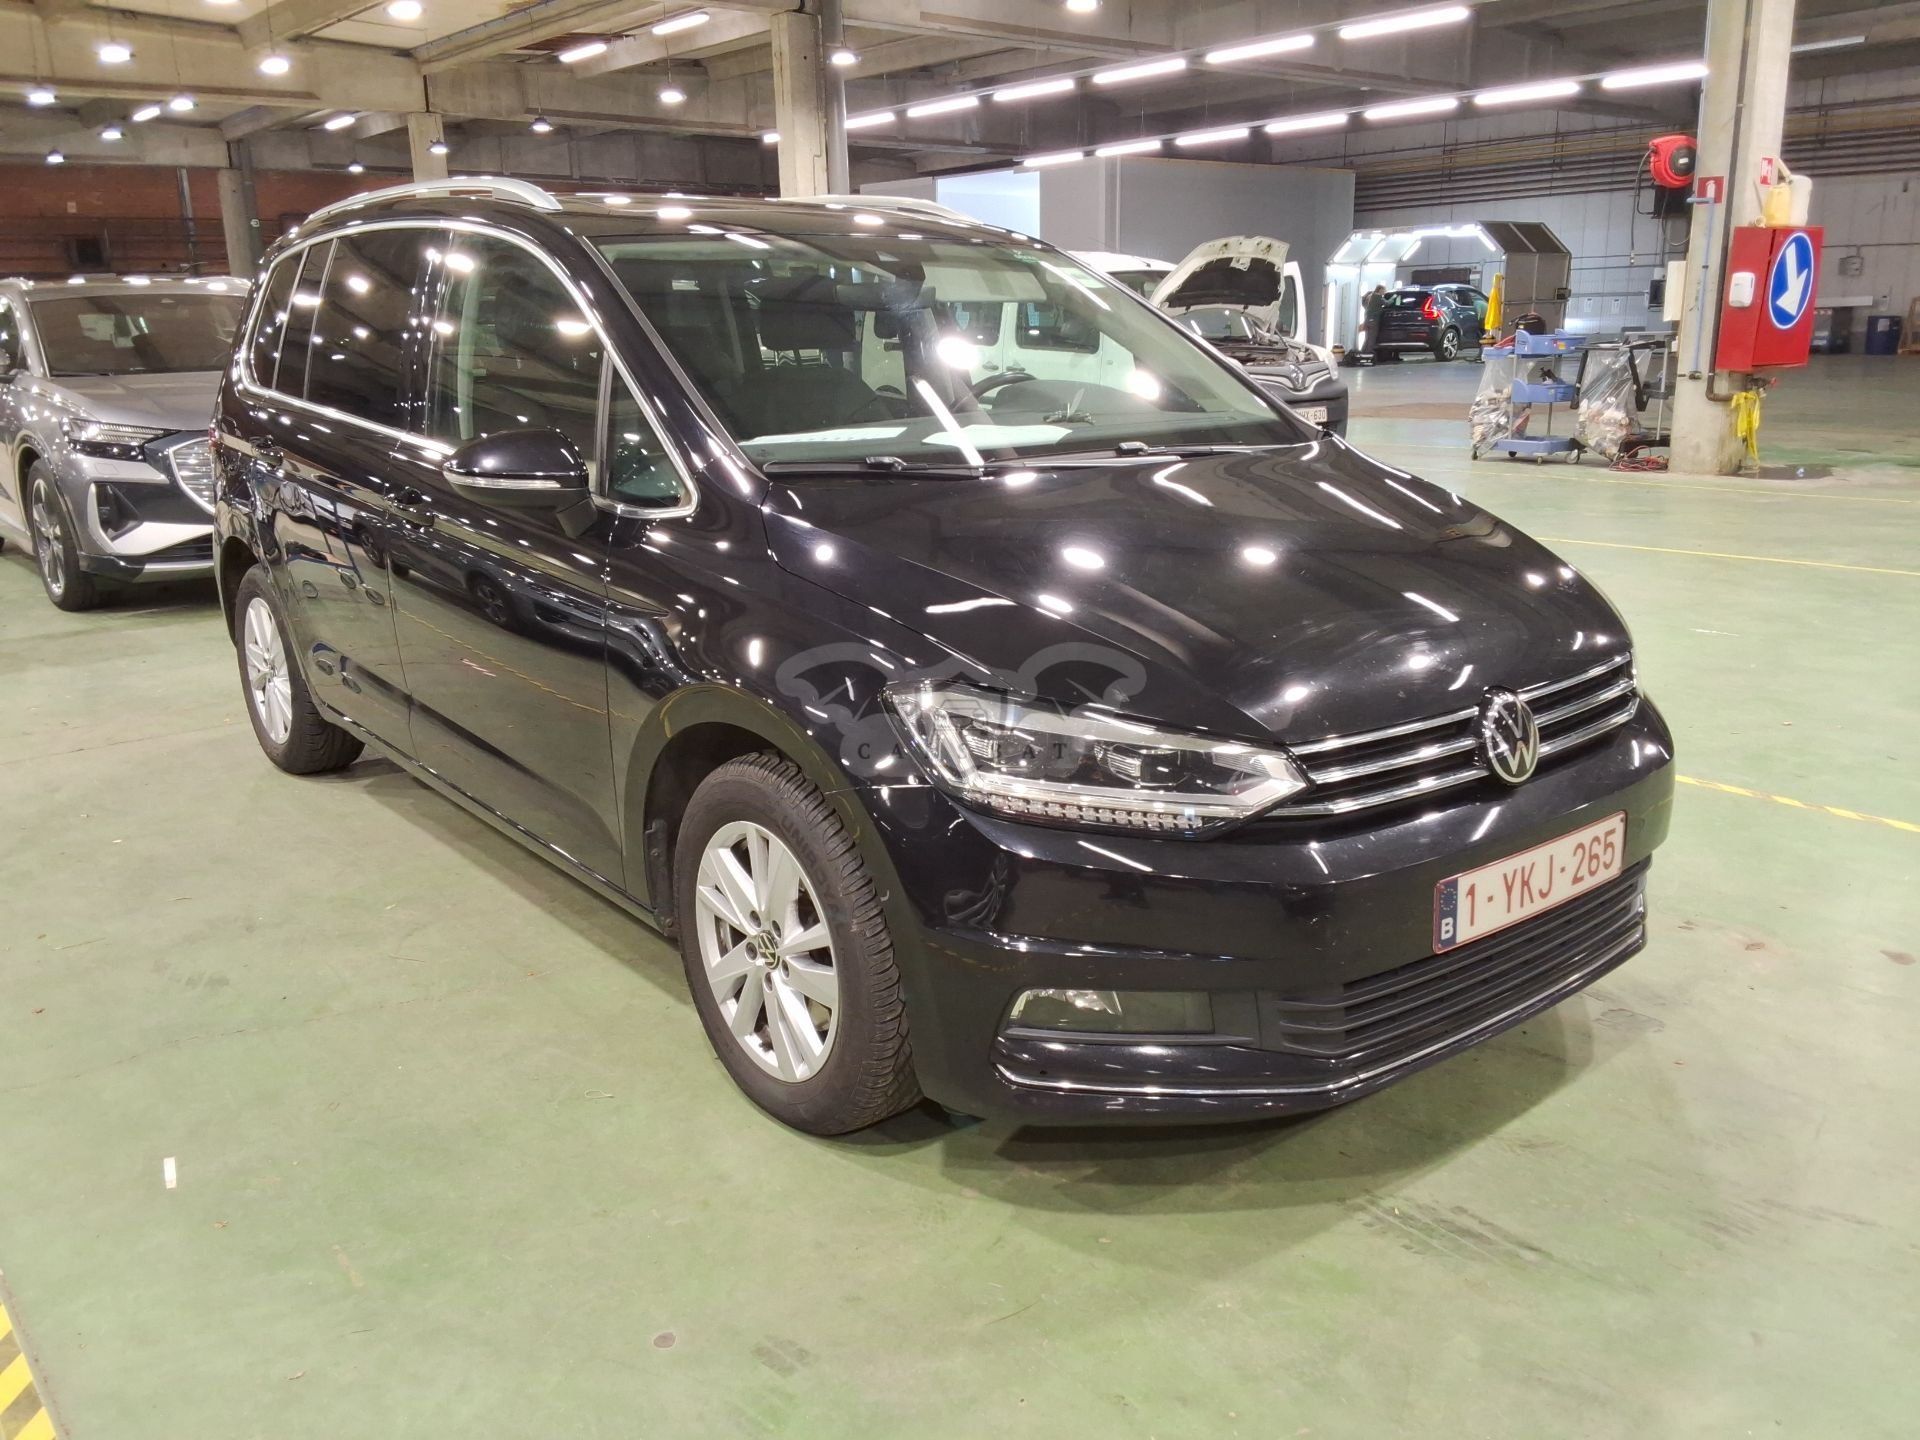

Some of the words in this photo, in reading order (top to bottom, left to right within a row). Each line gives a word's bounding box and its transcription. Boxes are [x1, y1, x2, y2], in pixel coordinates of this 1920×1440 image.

[780, 814, 846, 938] UNIROYAL
[1465, 827, 1618, 927] 1-YKJ-265
[1441, 916, 1454, 940] B
